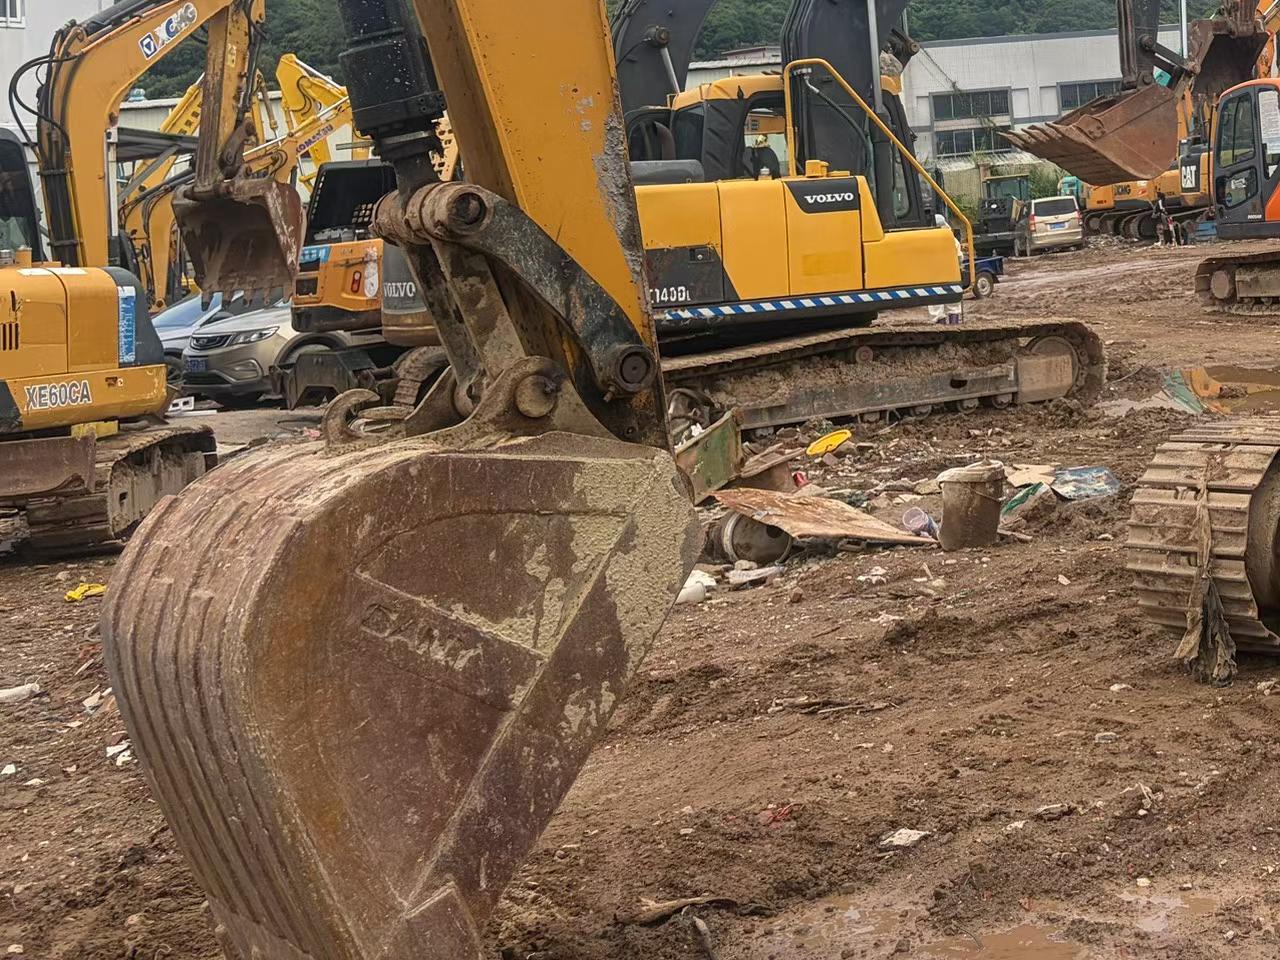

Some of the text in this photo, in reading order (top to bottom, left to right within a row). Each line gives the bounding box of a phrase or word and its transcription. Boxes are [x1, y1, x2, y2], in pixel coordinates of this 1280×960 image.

[1181, 165, 1197, 188] CAT
[804, 192, 855, 204] VOLVO
[383, 282, 416, 298] VOLVO
[24, 380, 93, 411] XE60CA
